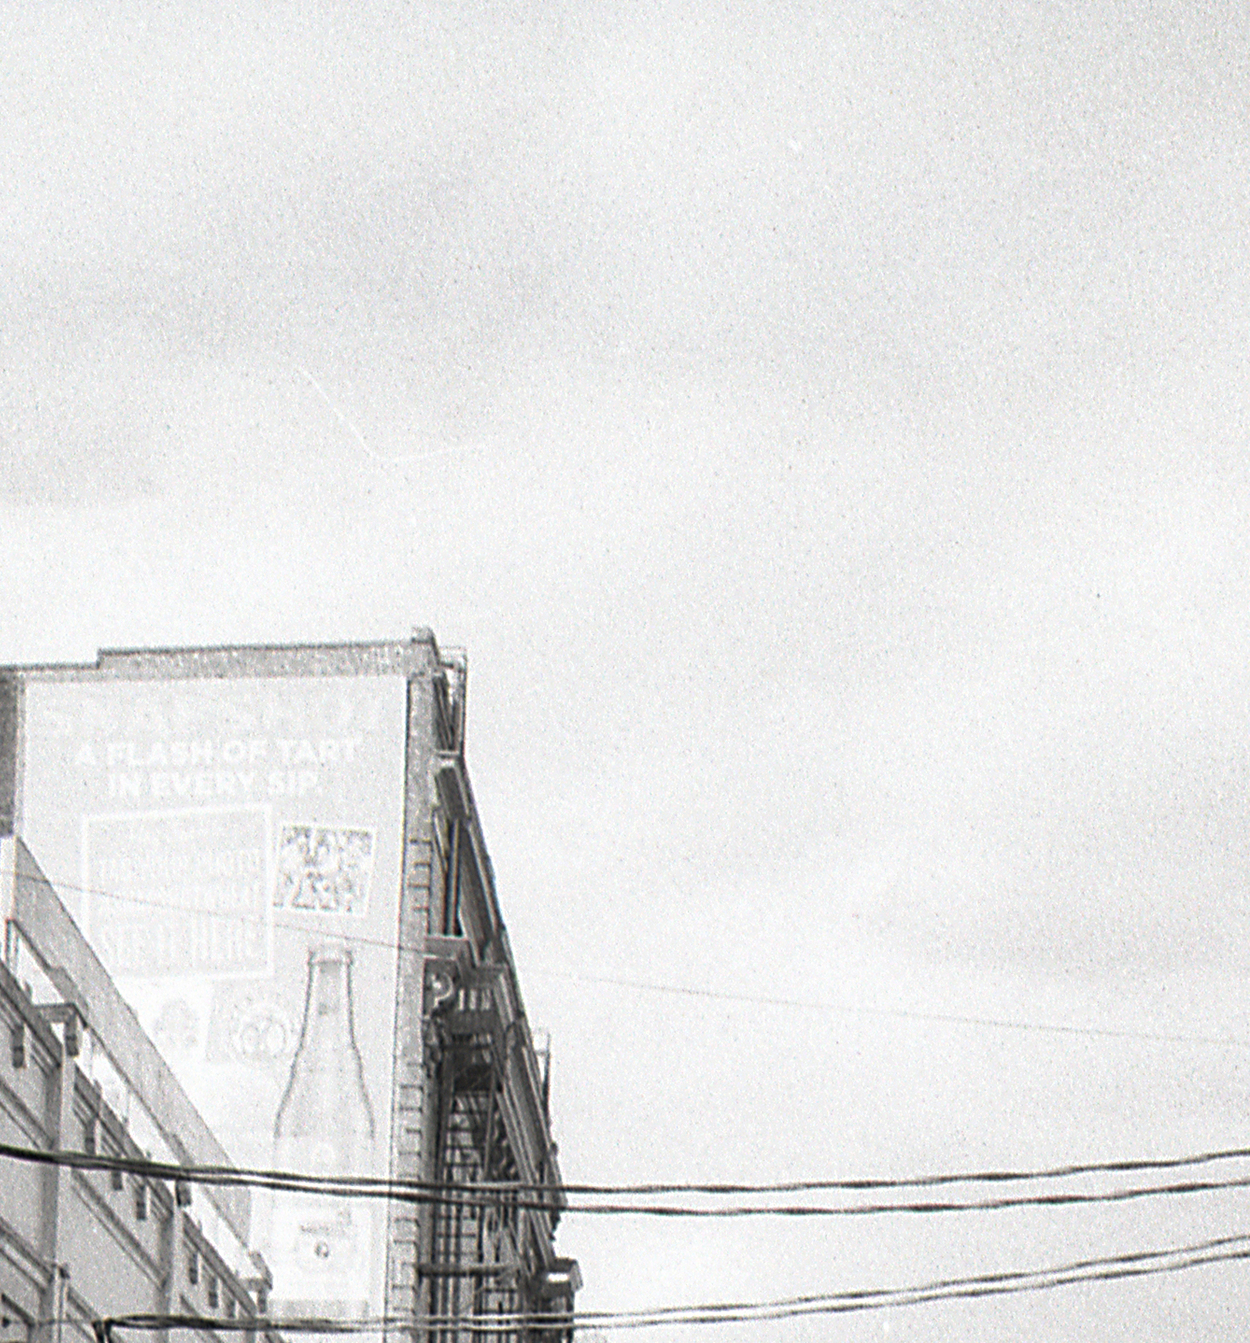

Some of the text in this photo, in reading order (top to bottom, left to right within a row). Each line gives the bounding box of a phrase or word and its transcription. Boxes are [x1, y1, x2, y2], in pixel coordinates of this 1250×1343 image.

[75, 734, 363, 766] A FLASH OF TART
[108, 773, 141, 798] IN
[150, 771, 257, 797] EVERY
